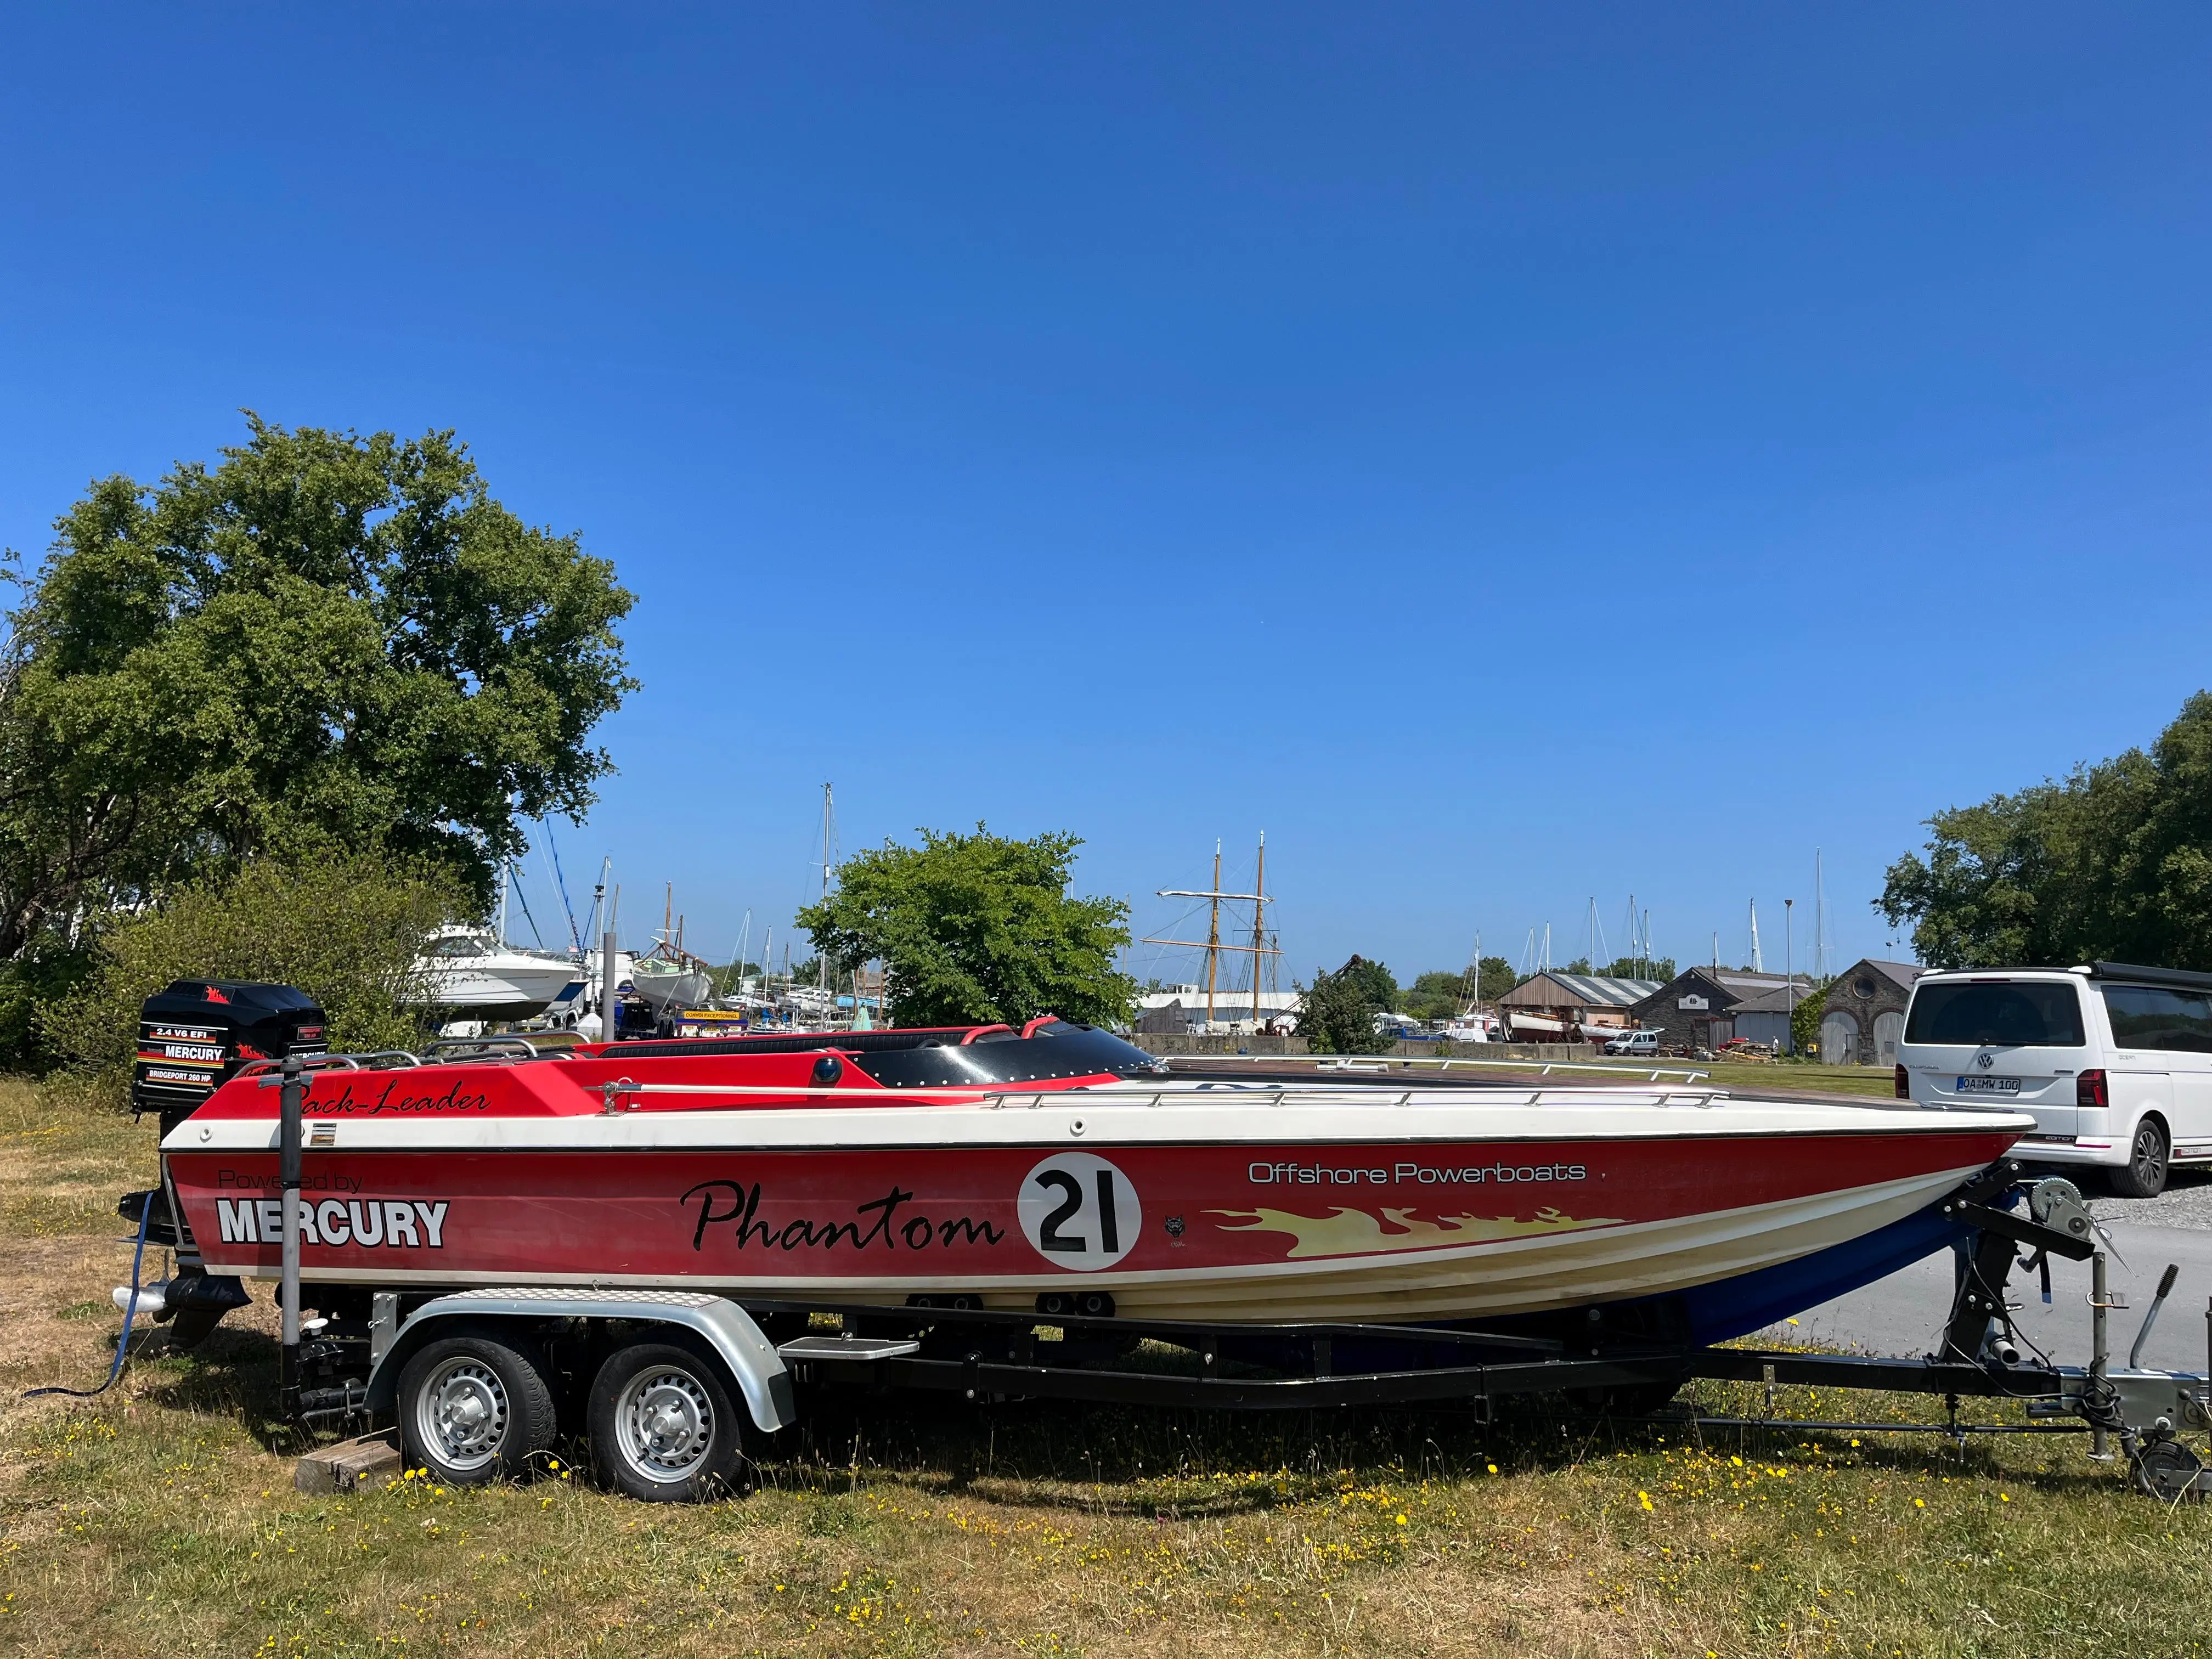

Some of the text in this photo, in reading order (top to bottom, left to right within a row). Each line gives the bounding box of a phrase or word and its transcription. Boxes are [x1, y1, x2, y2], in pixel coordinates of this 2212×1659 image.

[165, 1045, 222, 1061] MERCURY
[149, 1070, 188, 1080] BRIDGEPORT
[188, 1074, 200, 1082] 260
[1964, 1079, 2019, 1090] OA MW 100
[218, 1169, 363, 1194] Poweed by
[1248, 1161, 1587, 1185] Offshore Powerboats
[680, 1179, 1005, 1252] Phantom
[1035, 1169, 1119, 1253] 21
